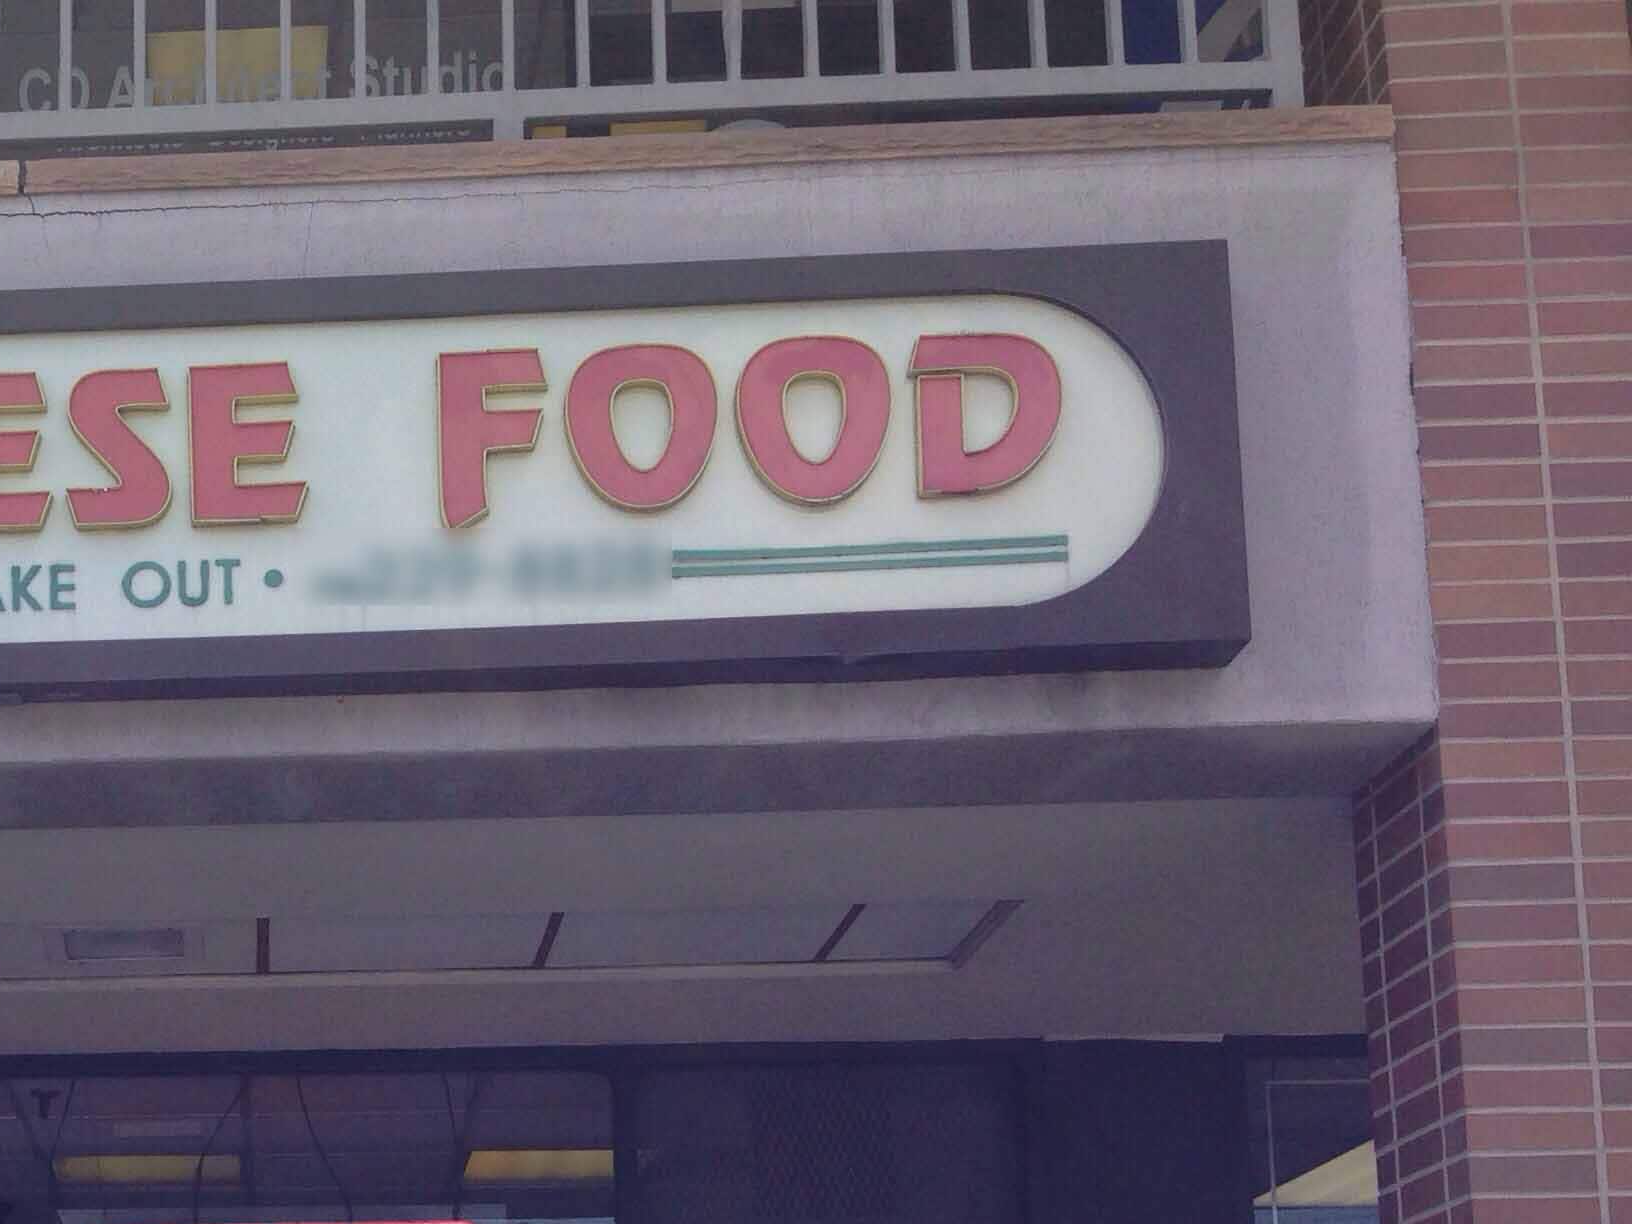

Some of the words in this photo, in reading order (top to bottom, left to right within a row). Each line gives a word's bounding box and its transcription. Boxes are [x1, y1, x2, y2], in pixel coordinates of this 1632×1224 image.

[348, 51, 506, 98] Studio
[437, 331, 1062, 529] FOOD
[121, 558, 242, 609] OUT
